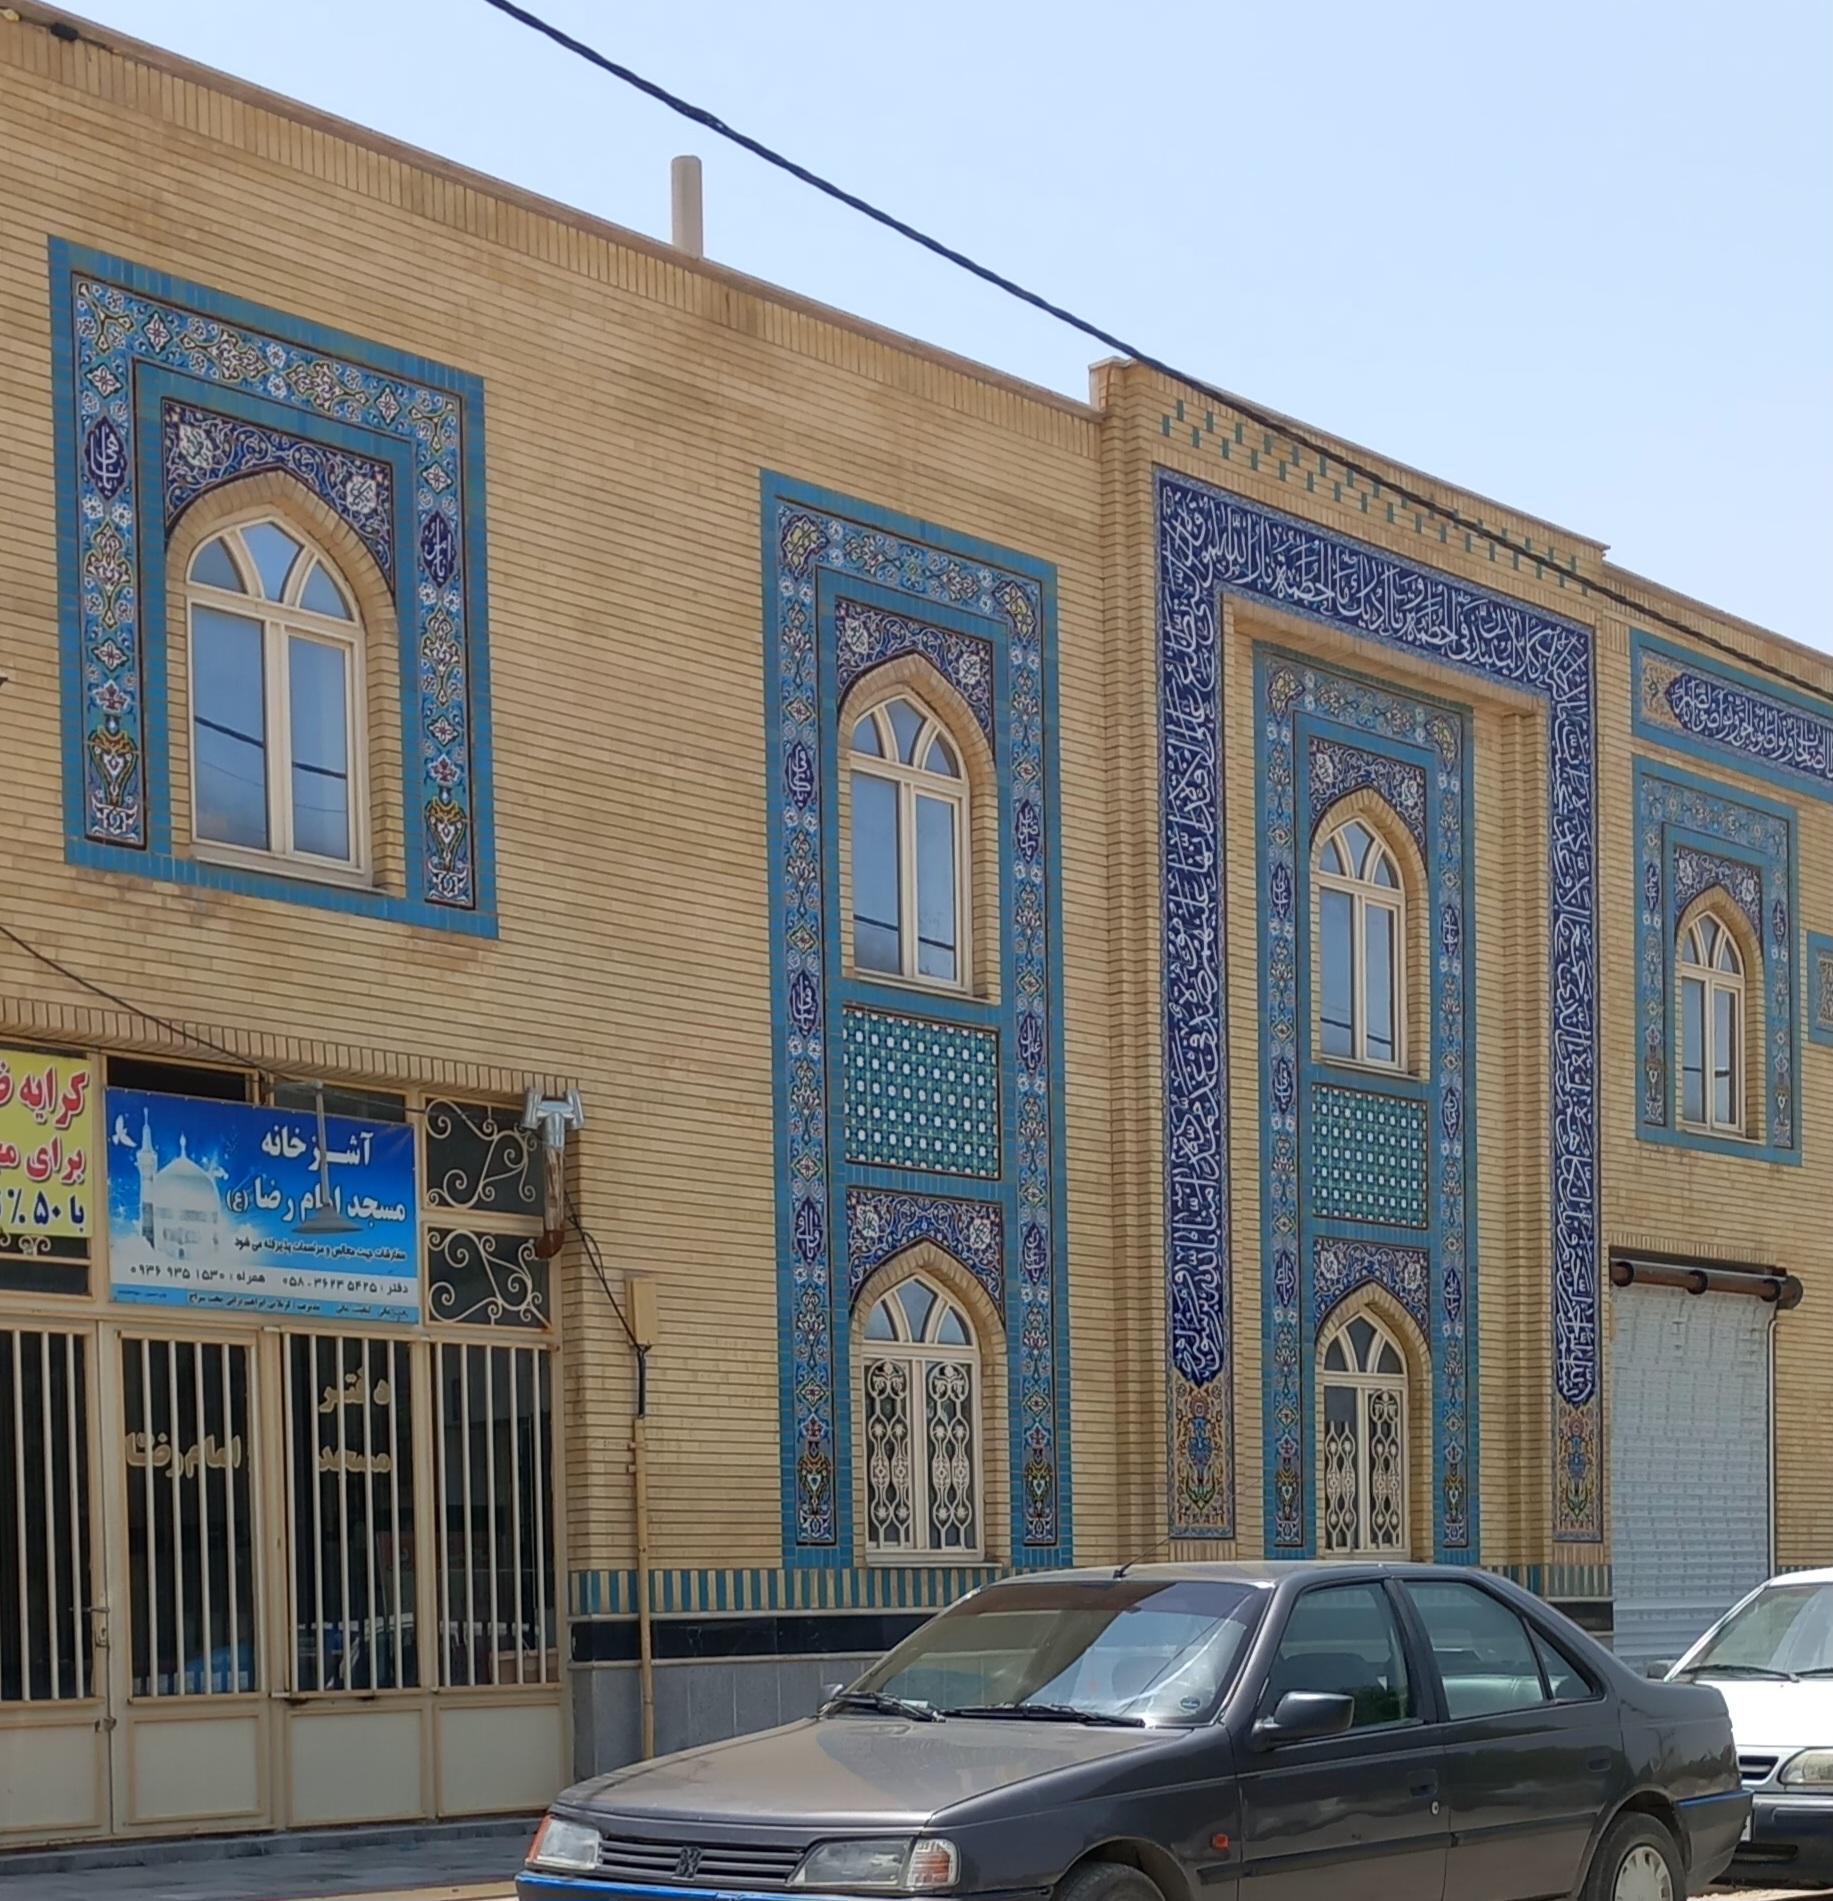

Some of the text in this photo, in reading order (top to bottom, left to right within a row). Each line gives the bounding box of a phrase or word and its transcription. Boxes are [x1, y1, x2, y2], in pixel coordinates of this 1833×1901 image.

[20, 1068, 89, 1128] کرایه
[26, 1137, 86, 1184] برای
[69, 1194, 85, 1232] با
[254, 1175, 295, 1222] رضا
[346, 1193, 407, 1228] مسجد
[318, 1366, 392, 1413] دفتر
[184, 1434, 242, 1480] امام
[318, 1445, 392, 1480] مسجد
